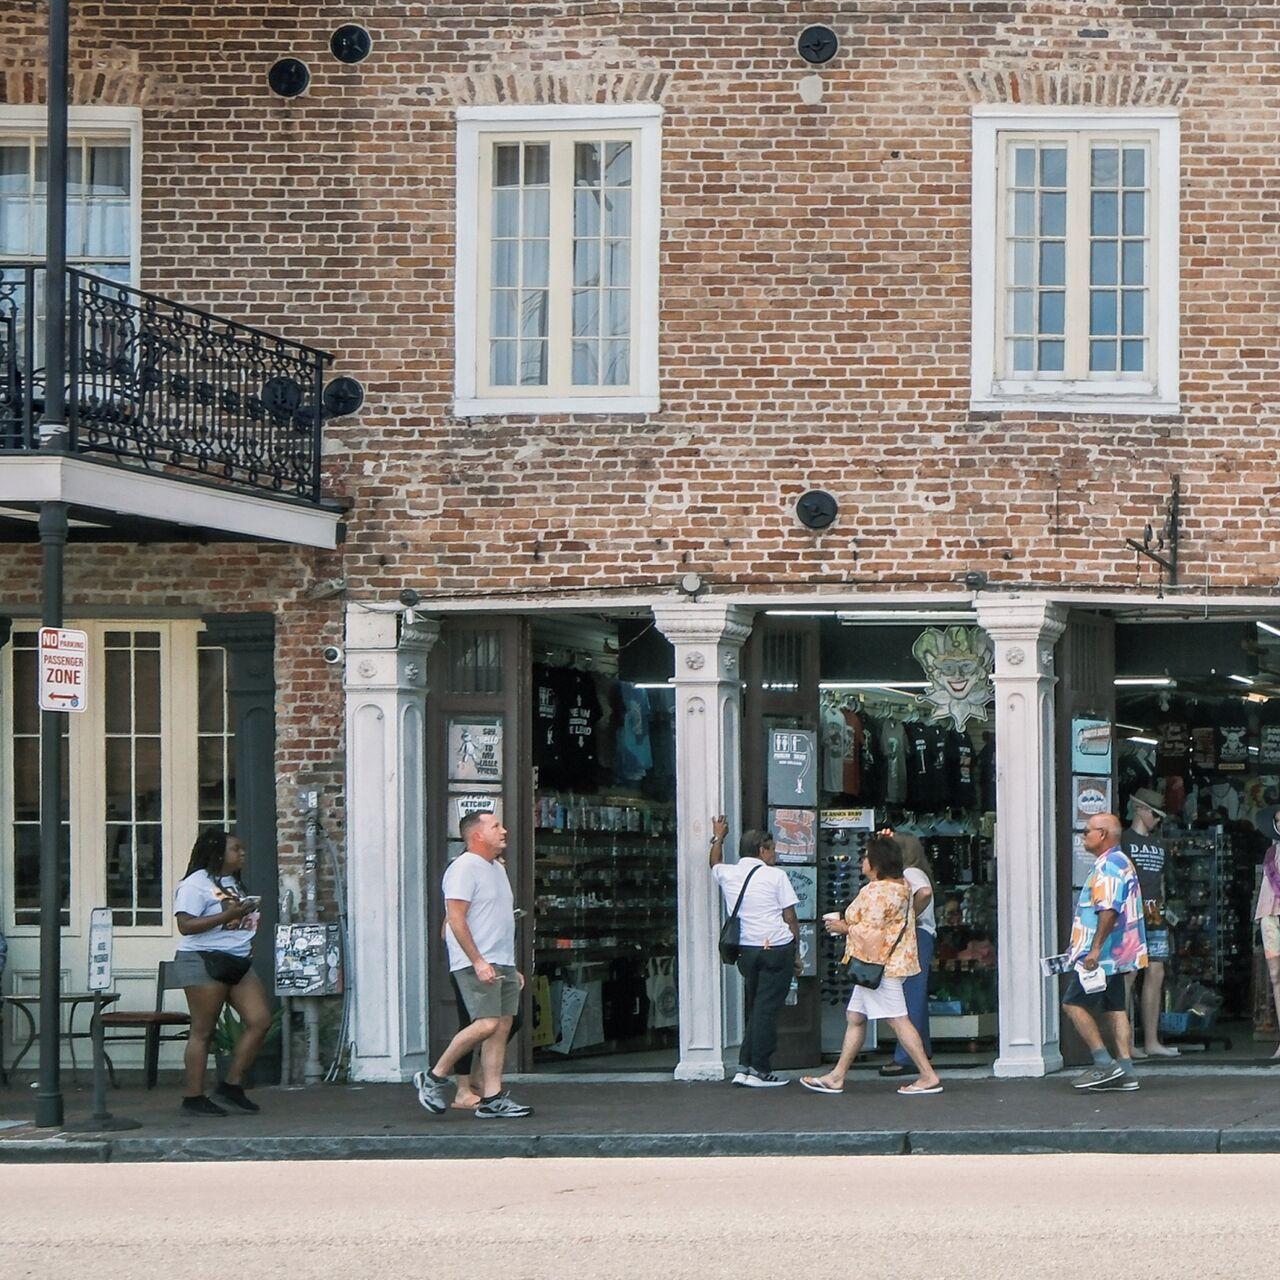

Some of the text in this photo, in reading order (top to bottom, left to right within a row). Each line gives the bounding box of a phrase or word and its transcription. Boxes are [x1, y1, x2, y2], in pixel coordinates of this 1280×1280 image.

[42, 632, 84, 648] NO PARKING
[43, 655, 84, 666] PASSENGER
[46, 668, 81, 685] ZONE
[460, 800, 492, 808] KETCHUP
